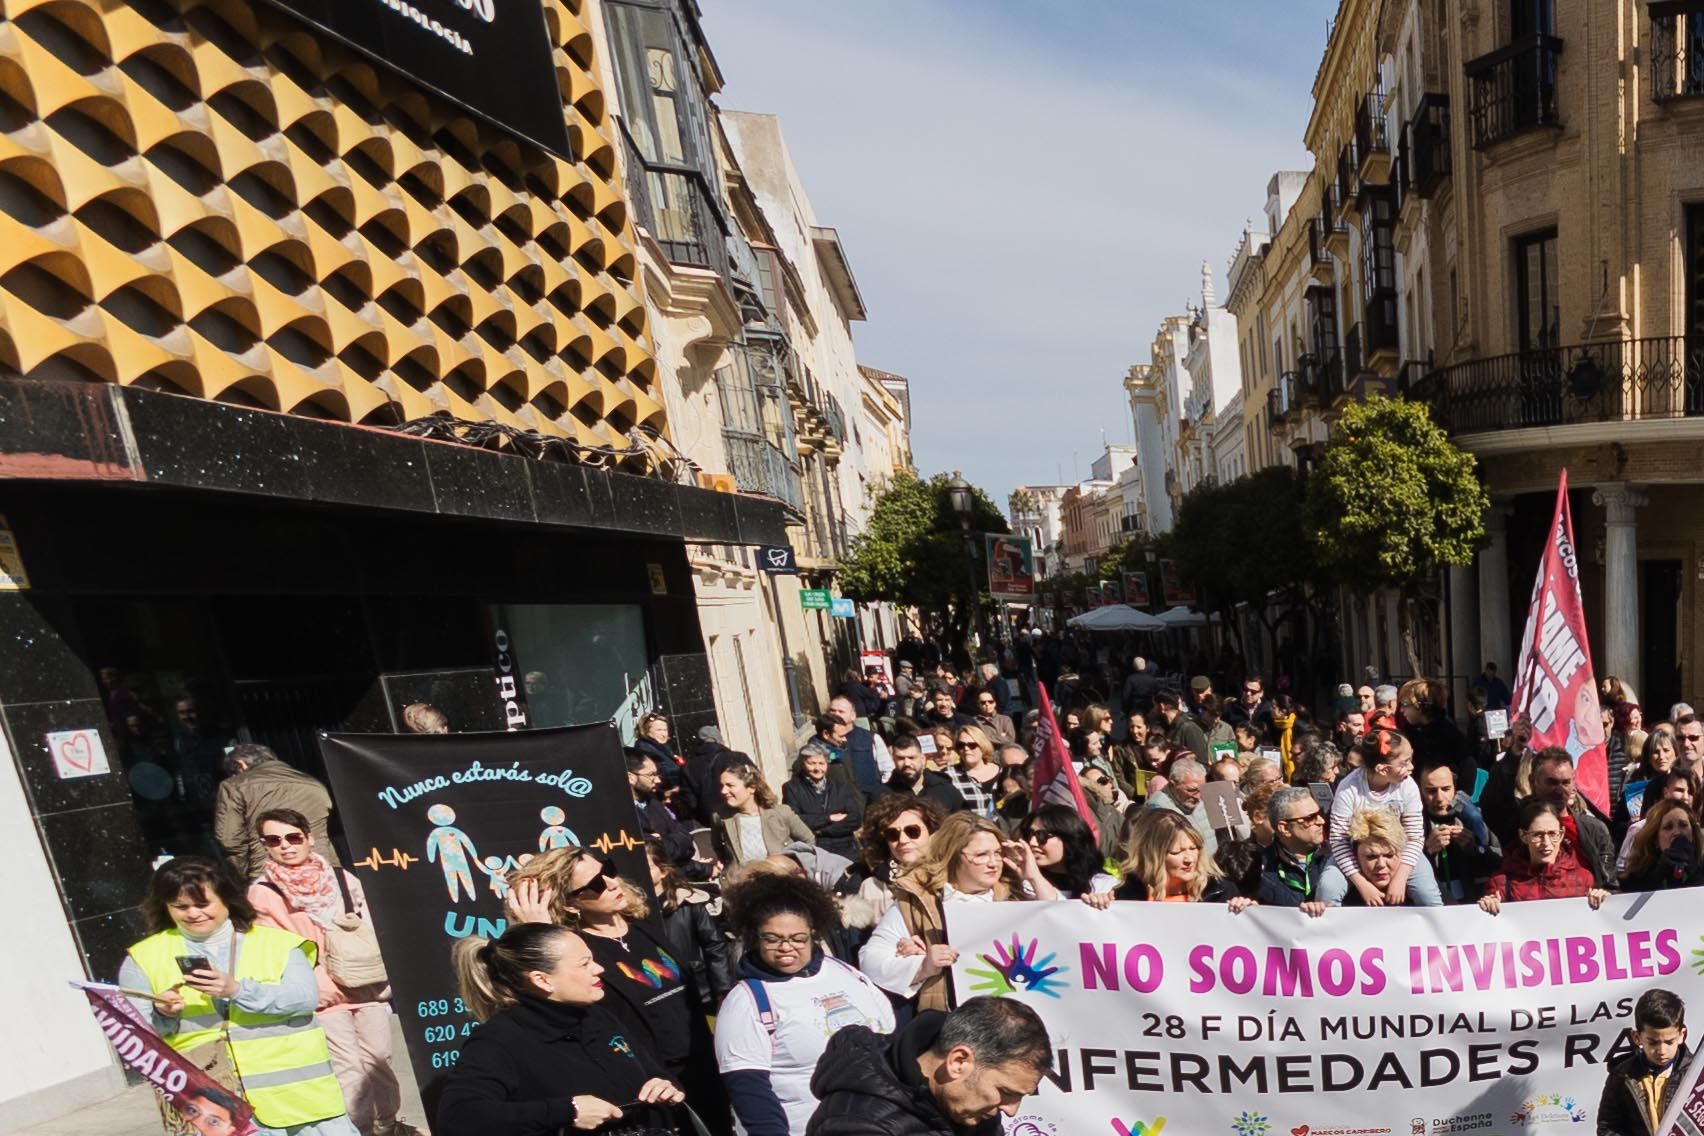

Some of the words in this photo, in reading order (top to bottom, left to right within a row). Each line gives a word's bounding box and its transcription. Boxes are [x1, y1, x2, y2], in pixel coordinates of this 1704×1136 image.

[494, 629, 528, 732] ptico
[378, 774, 450, 810] Nunca
[452, 760, 533, 785] estarás
[534, 769, 593, 798] sol@
[1078, 942, 1164, 994] NO
[1188, 944, 1387, 998] SOMOS
[1408, 928, 1682, 995] INVISIBLES
[417, 999, 449, 1018] 689
[1141, 1011, 1187, 1040] 28
[1201, 1015, 1222, 1041] F
[1237, 1008, 1307, 1042] DÍA
[1320, 1010, 1497, 1041] MUNDIAL
[1510, 1005, 1557, 1032] DE
[1569, 997, 1634, 1027] LAS
[424, 1024, 456, 1043] 620
[431, 1050, 460, 1069] 619
[1029, 1039, 1540, 1096] NFERMEDADES
[1432, 1112, 1493, 1127] Duchenne
[1450, 1119, 1493, 1133] España
